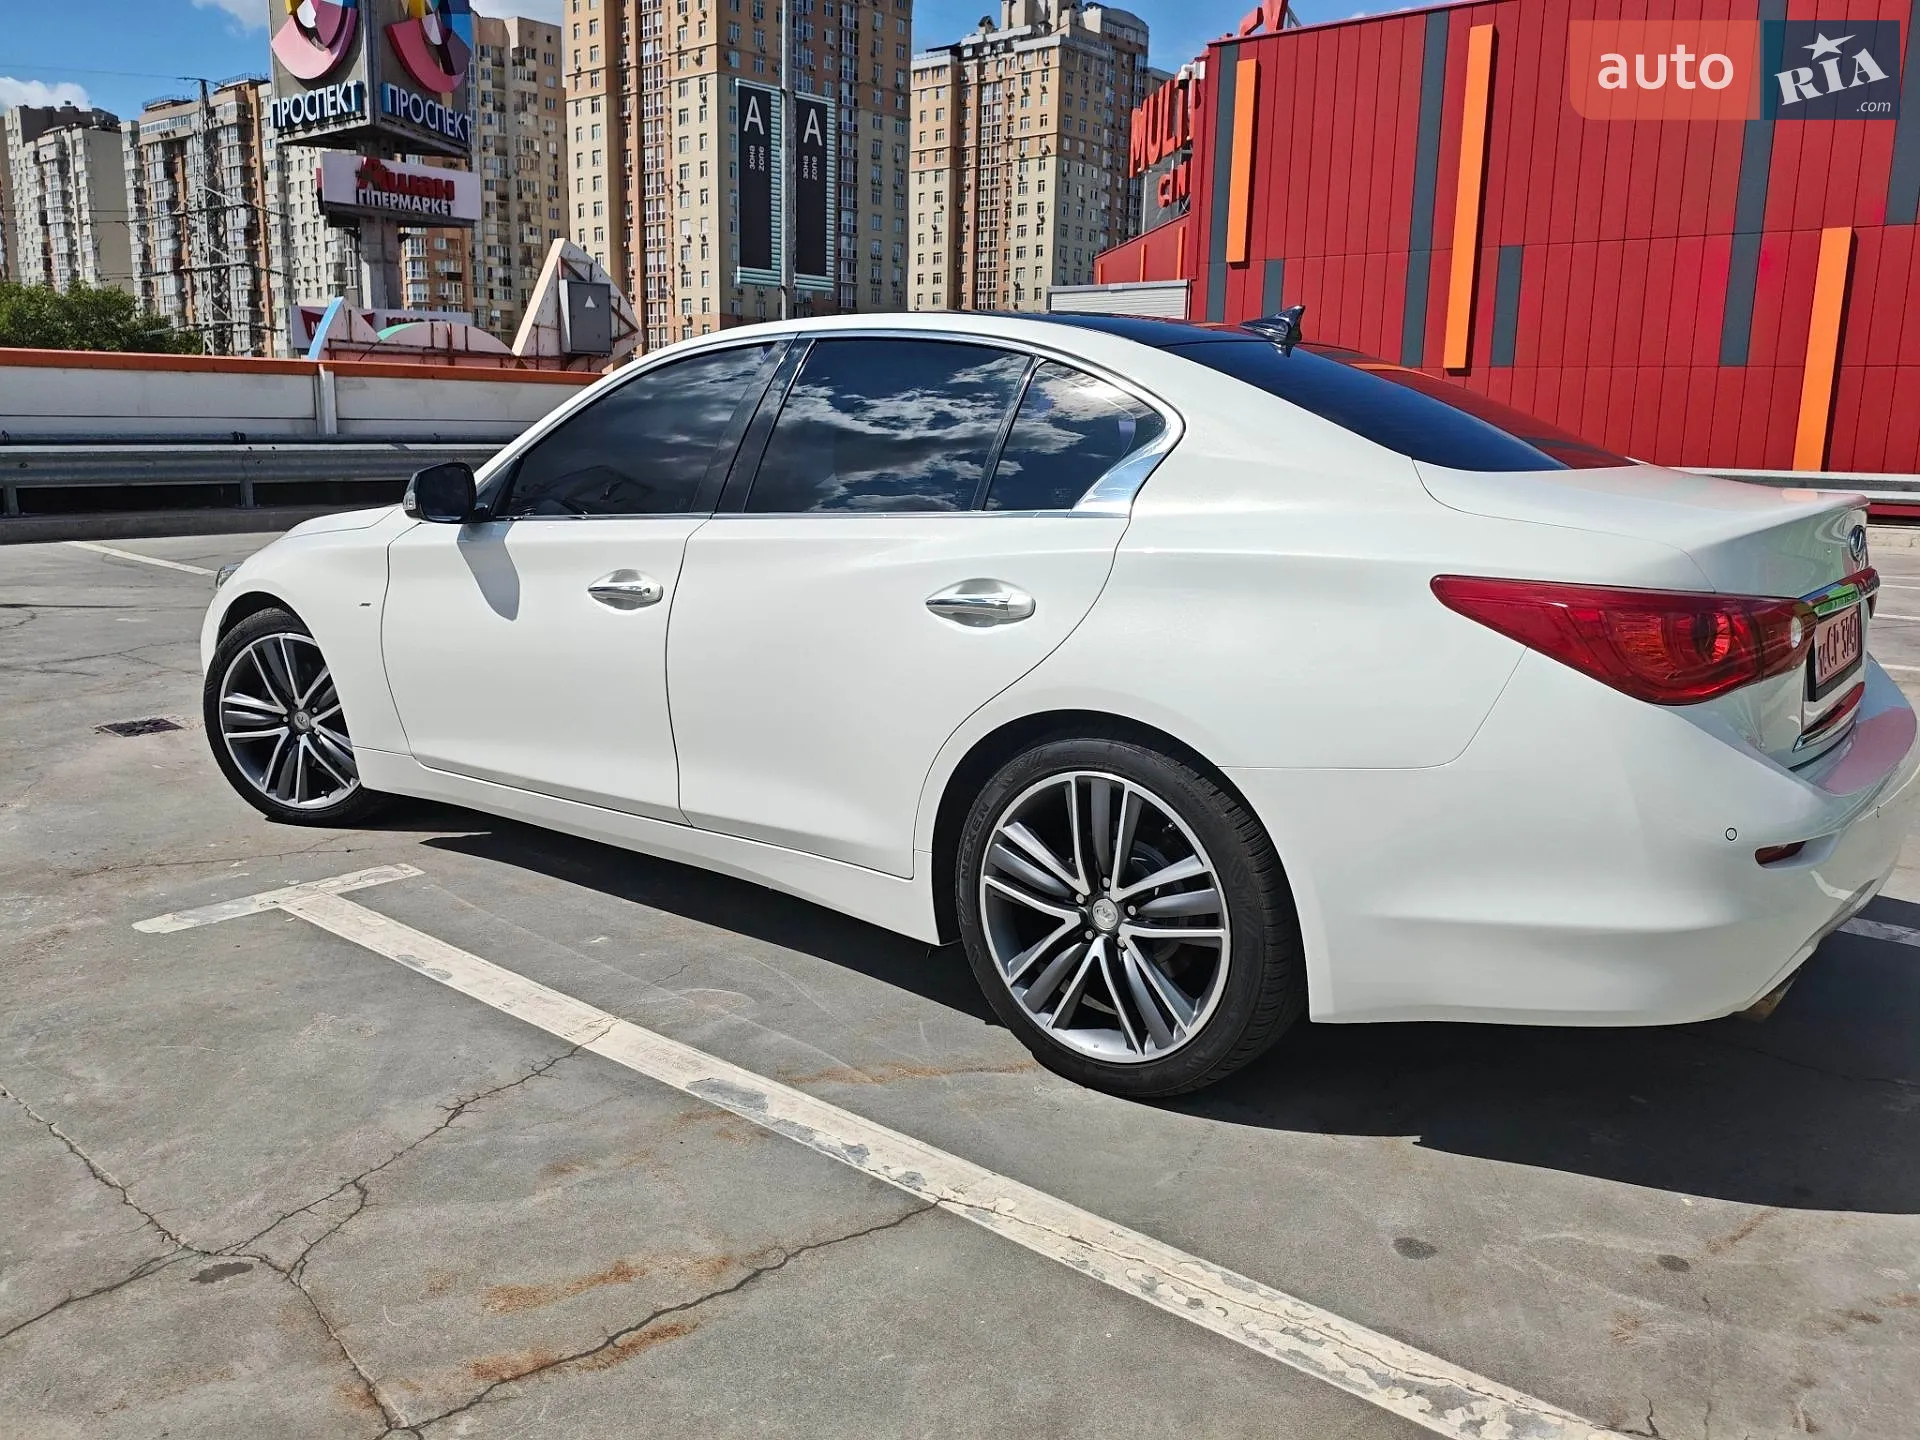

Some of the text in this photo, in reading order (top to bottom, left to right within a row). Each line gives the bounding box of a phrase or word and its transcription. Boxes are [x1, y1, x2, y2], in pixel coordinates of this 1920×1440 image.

[270, 80, 360, 127] ПРОСПЕКТ
[387, 83, 472, 142] ПРОСПЕКТ
[743, 95, 764, 135] A
[803, 108, 823, 146] A
[357, 188, 454, 216] ГІПЕРМАРКЕТ
